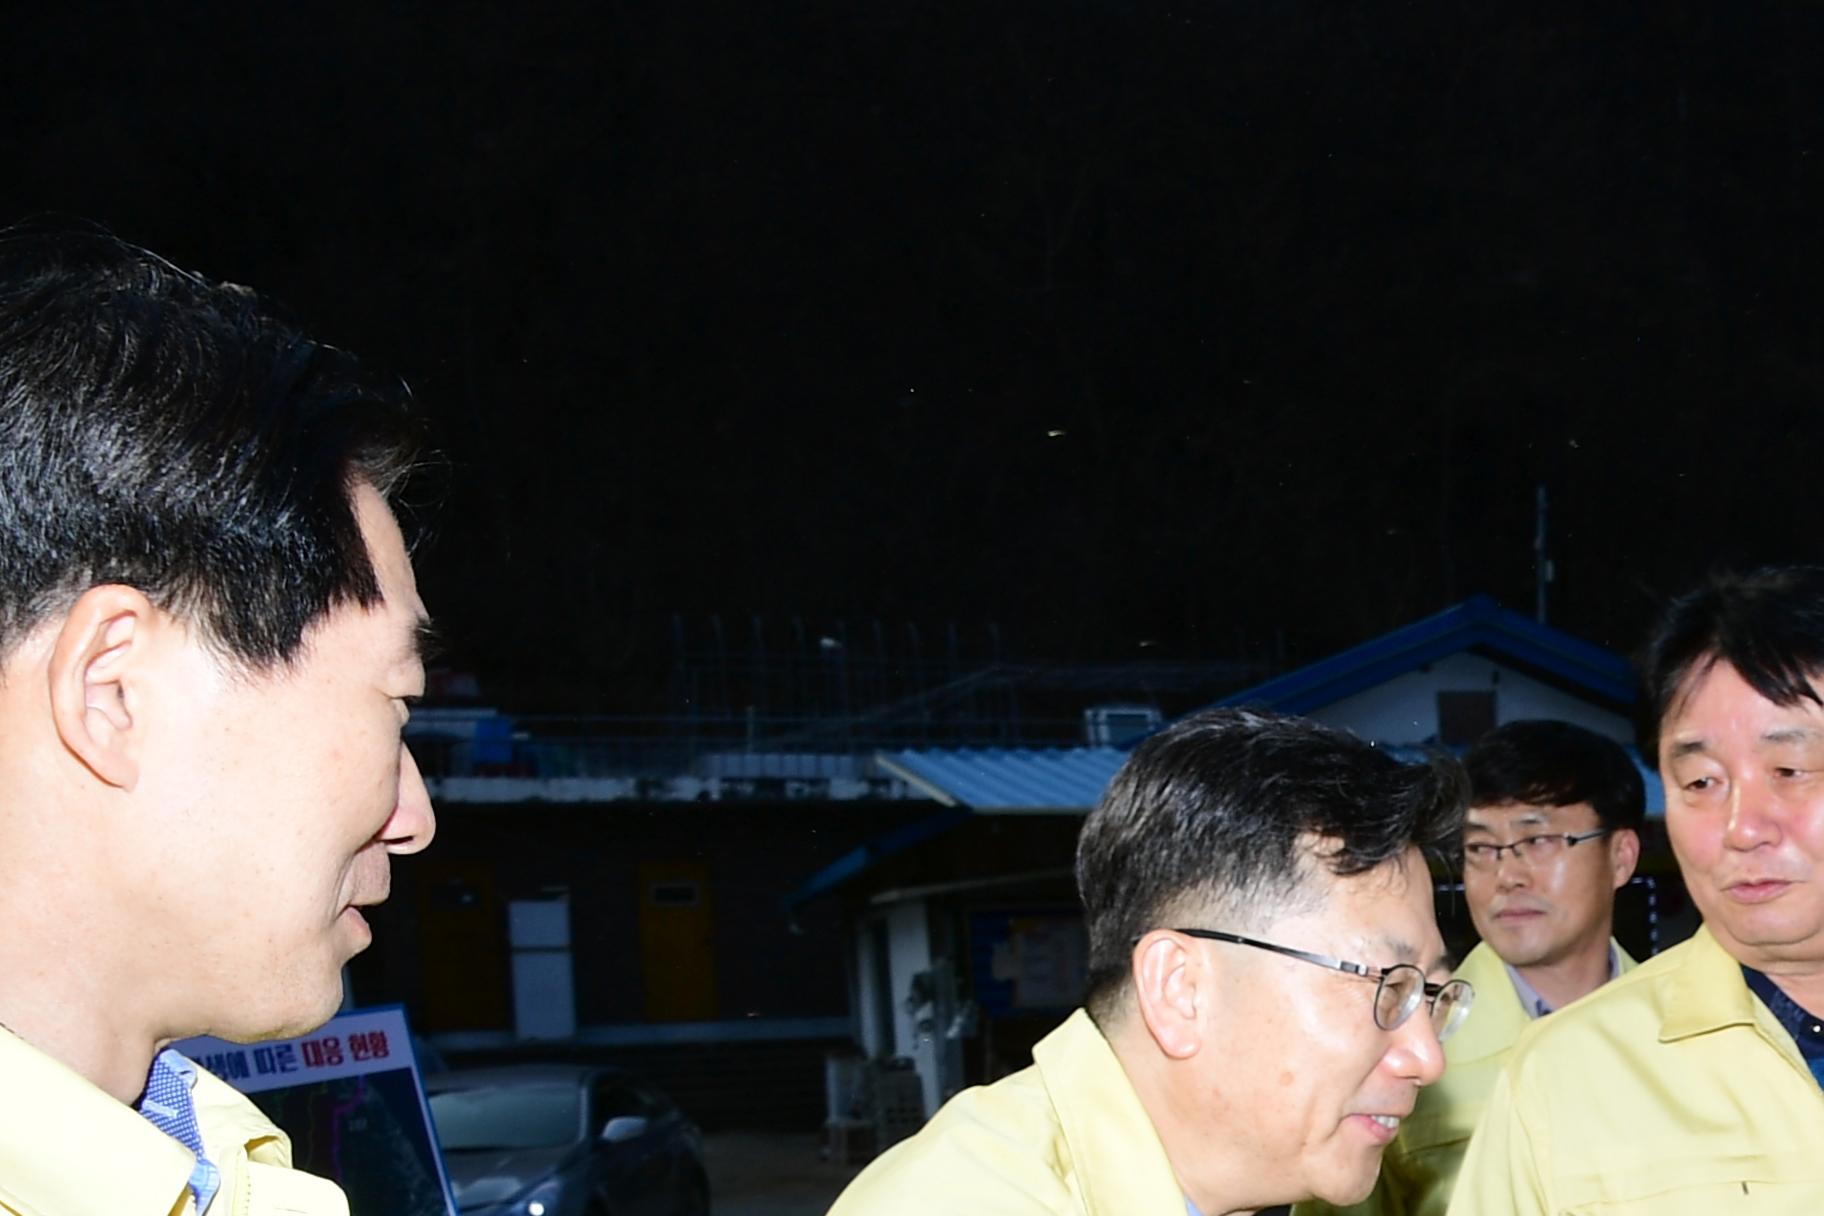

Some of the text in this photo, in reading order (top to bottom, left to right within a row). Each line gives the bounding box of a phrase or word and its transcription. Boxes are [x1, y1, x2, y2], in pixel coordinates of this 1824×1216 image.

[253, 1043, 298, 1075] 따른
[302, 1037, 344, 1068] 대응
[349, 1031, 390, 1062] 현황
